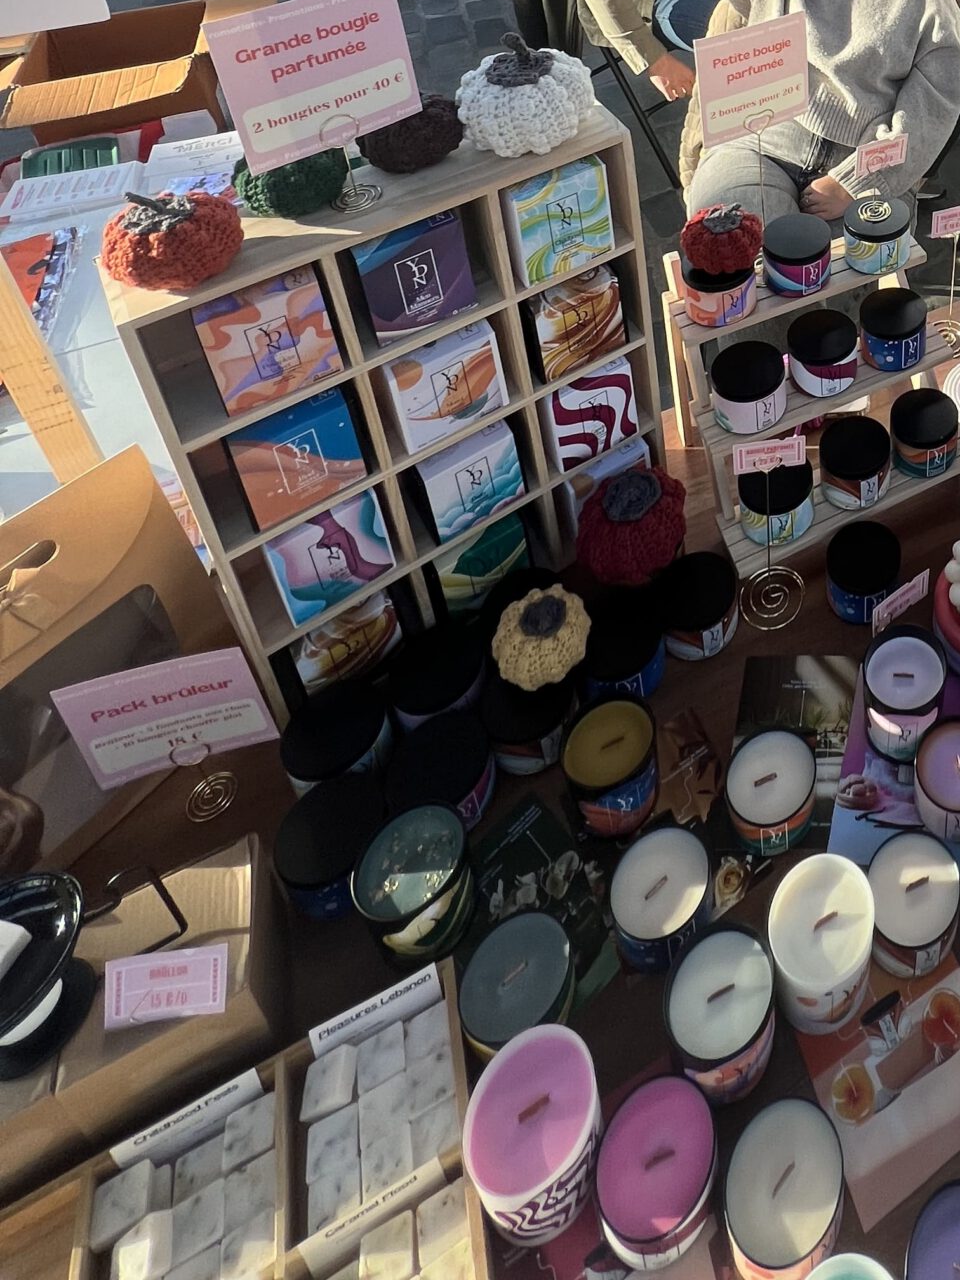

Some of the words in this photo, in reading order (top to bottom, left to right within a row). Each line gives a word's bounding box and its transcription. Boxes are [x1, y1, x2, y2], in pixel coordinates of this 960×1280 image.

[208, 21, 261, 39] romotions
[235, 32, 312, 64] Grande
[316, 11, 380, 40] bougie
[271, 40, 367, 84] parfumée
[712, 51, 750, 69] Petite
[753, 39, 792, 57] bougie
[726, 57, 785, 84] parfumée
[252, 122, 264, 134] 2
[267, 99, 331, 129] bougies
[334, 87, 369, 109] pour
[372, 76, 390, 92] 40
[394, 72, 404, 83] €
[710, 111, 717, 120] 2
[719, 100, 757, 117] bougies
[759, 91, 781, 107] pour
[782, 86, 794, 97] 20
[90, 701, 148, 723] Pack
[151, 678, 233, 705] brûleur
[318, 1001, 378, 1041] Pleasures
[380, 973, 431, 1006] Lebanon
[133, 1104, 202, 1146] Childhood
[325, 1200, 379, 1238] Caramel
